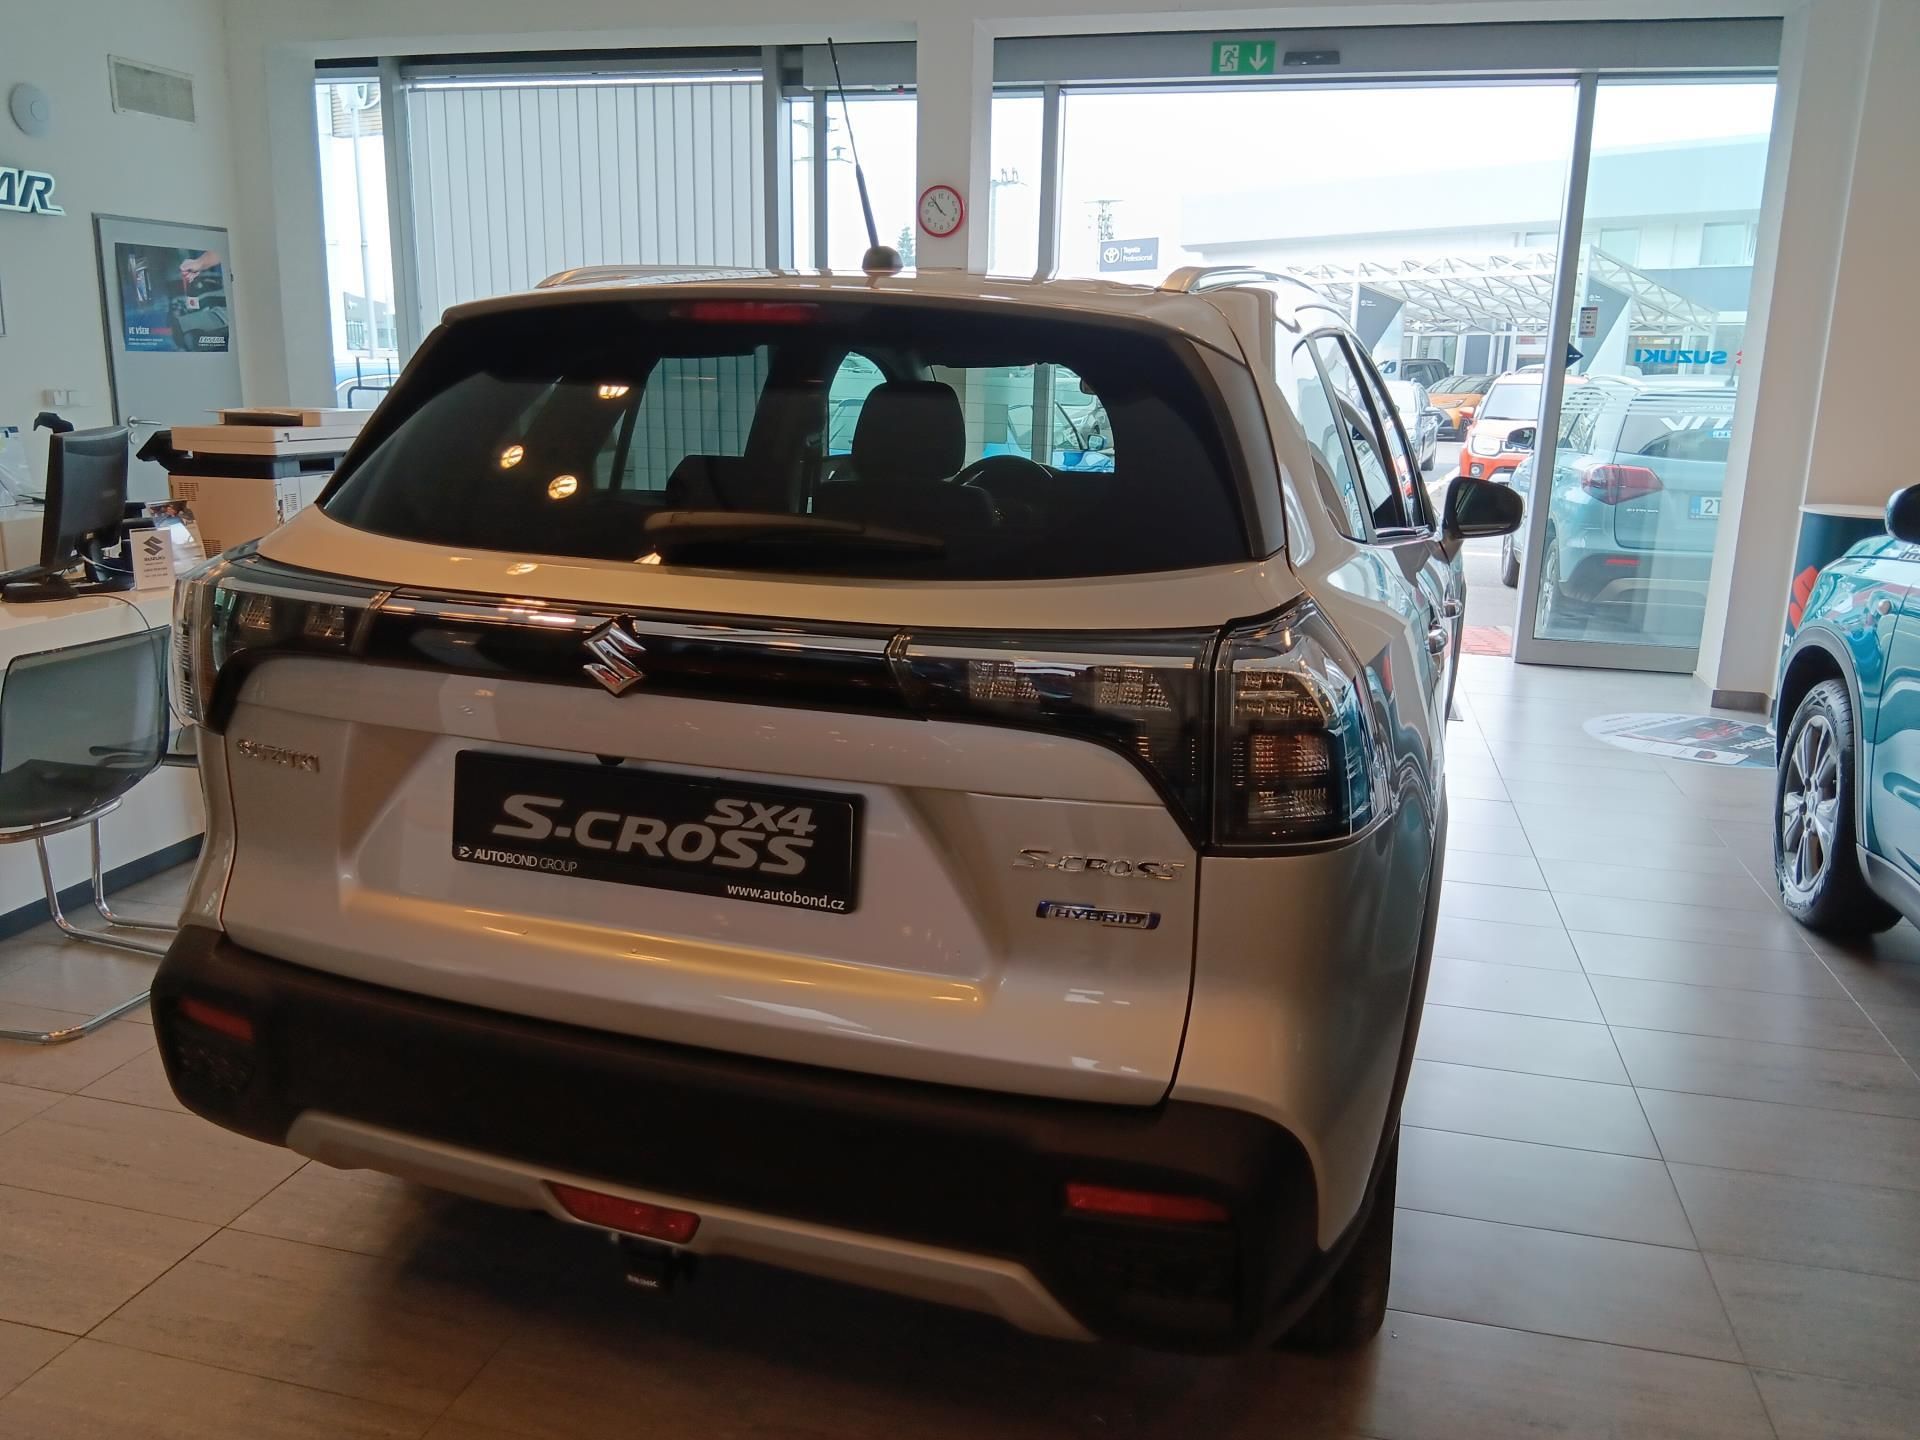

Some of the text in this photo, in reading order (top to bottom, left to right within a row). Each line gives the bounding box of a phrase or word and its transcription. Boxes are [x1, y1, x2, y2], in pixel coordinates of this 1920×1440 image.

[1660, 415, 1733, 431] VIT
[704, 798, 817, 836] SX4
[473, 847, 578, 873] AUTOBOND GROUP
[727, 883, 845, 911] www.autobond.cz
[1054, 908, 1145, 925] HYBRID
